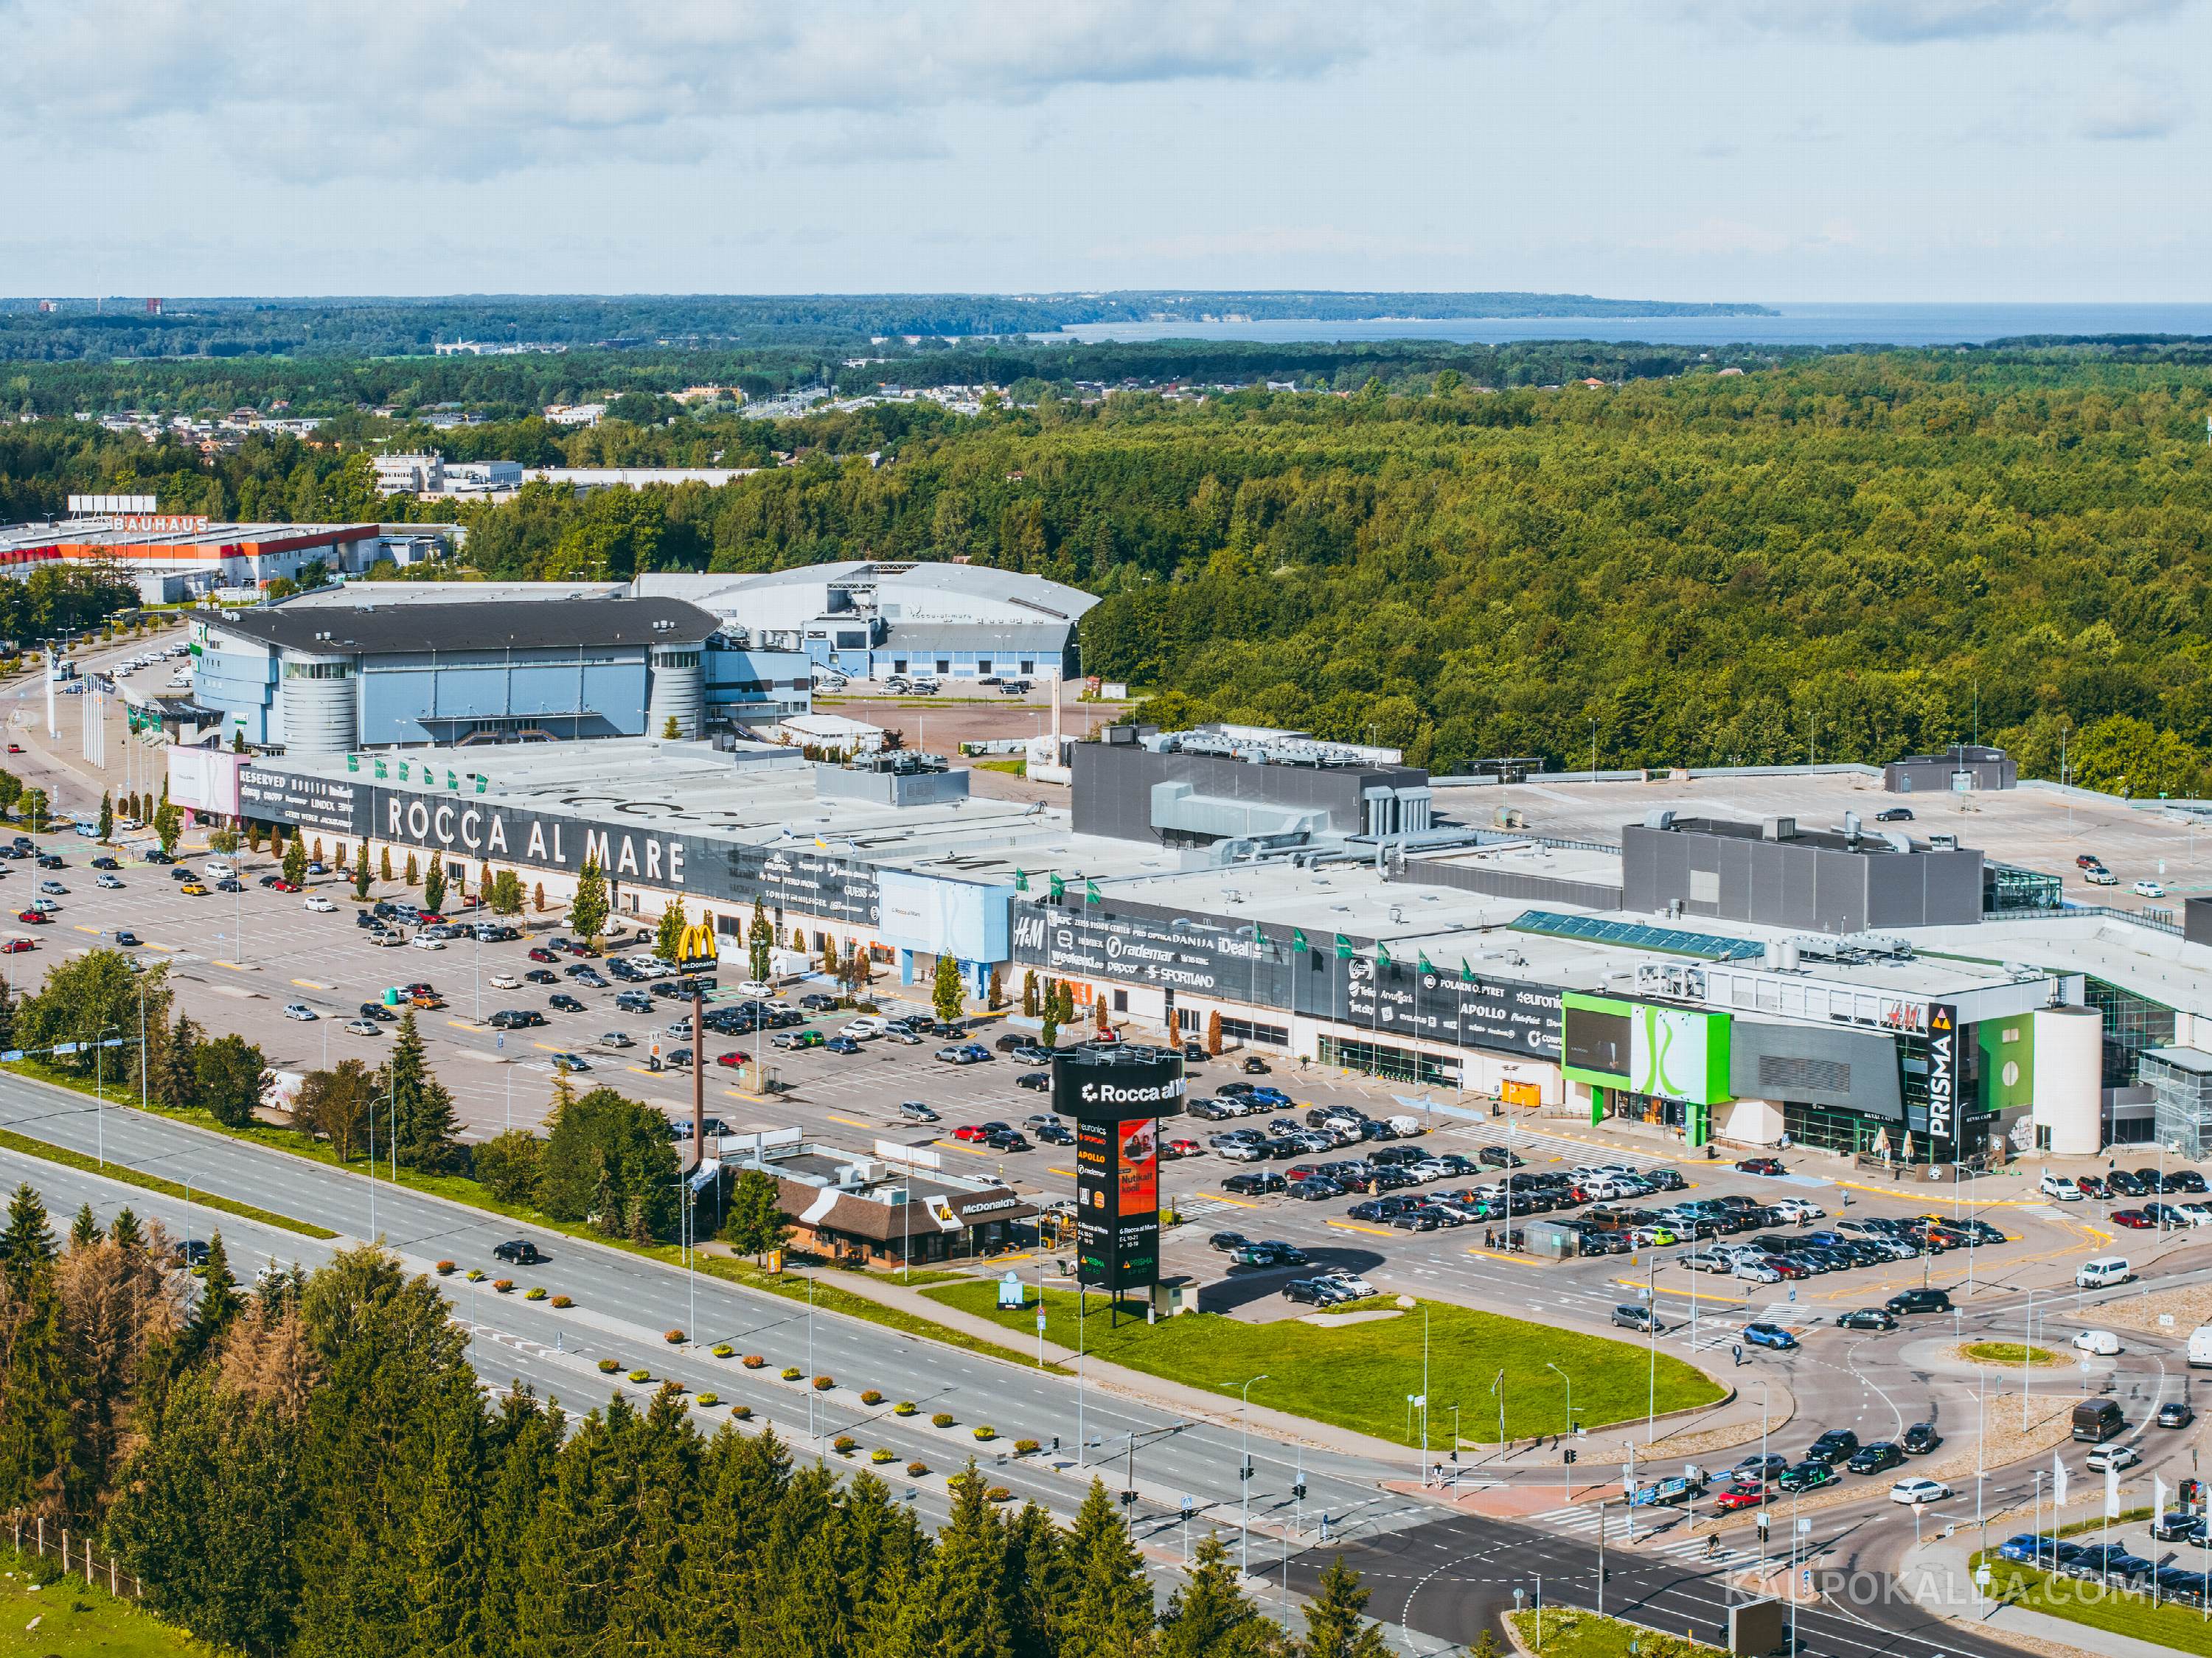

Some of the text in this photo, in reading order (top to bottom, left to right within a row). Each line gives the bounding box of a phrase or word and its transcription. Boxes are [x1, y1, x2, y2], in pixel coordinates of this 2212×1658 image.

[114, 518, 207, 531] BAUHAUS
[240, 770, 285, 788] RESERVED
[311, 798, 335, 812] LINDEX
[301, 813, 319, 823] WEBER
[389, 797, 685, 883] ROCCA AL MARE
[784, 877, 800, 886] VERO
[801, 879, 820, 889] MODA
[844, 885, 868, 898] GUESS
[765, 890, 790, 901] TOMMY
[798, 895, 827, 908] HILFIGER
[1015, 916, 1045, 950] H&M
[1074, 919, 1130, 934] ZEISS VISION CENTER
[1147, 932, 1172, 941] OPTIKA
[1172, 934, 1215, 949] DANIJA
[1121, 944, 1175, 963] rademar
[1217, 937, 1250, 957] iDeal
[681, 961, 716, 969] McDonald's
[1161, 968, 1214, 988] SPORTLAND
[1360, 986, 1377, 997] Telia
[1440, 979, 1472, 992] POLARN
[1472, 985, 1481, 994] O.
[1482, 986, 1505, 997] PYRET
[1461, 1003, 1506, 1020] APOLLO
[1101, 1084, 1160, 1102] Rocca
[1161, 1080, 1175, 1099] al
[1930, 1035, 1951, 1138] PRISMA
[1082, 1124, 1106, 1135] euronics
[1078, 1151, 1105, 1163] APOLLO
[1085, 1168, 1106, 1177] rademar
[962, 1198, 1015, 1214] McDonald's
[1082, 1222, 1093, 1230] Rocca
[1086, 1256, 1105, 1268] PRISMA
[1130, 1257, 1153, 1267] PRISMA
